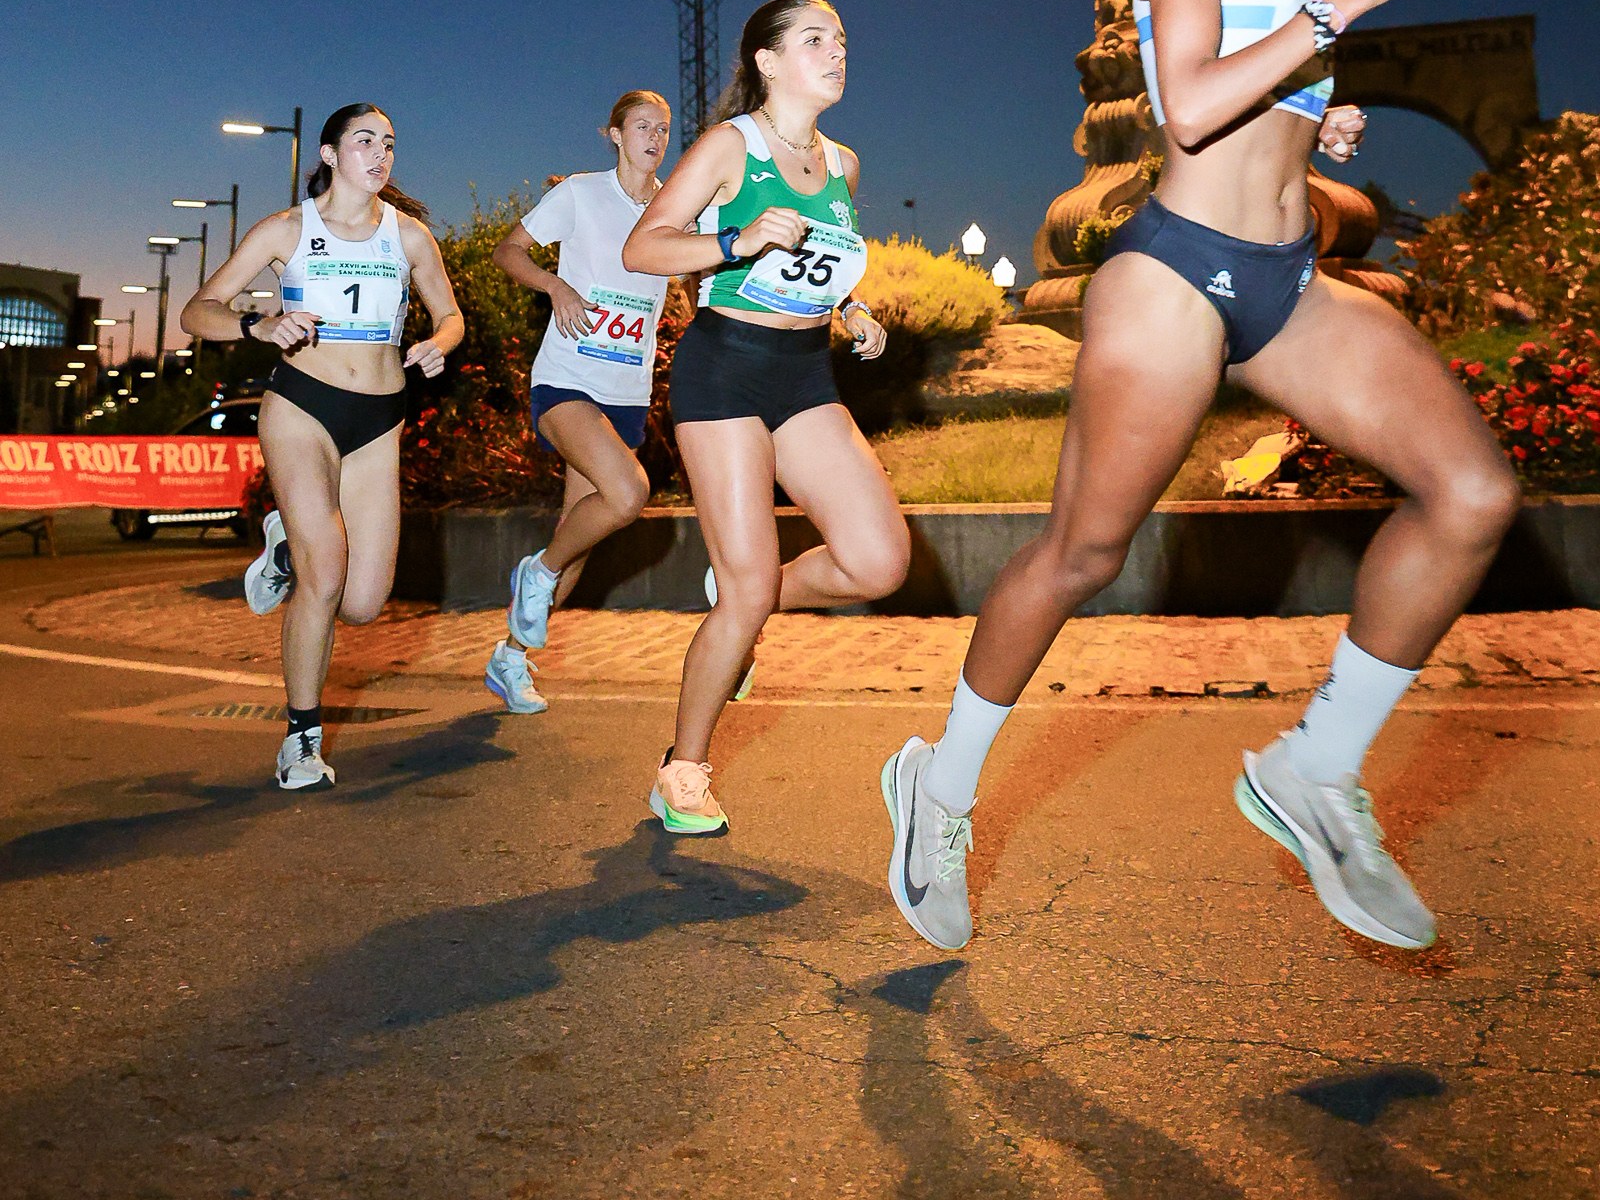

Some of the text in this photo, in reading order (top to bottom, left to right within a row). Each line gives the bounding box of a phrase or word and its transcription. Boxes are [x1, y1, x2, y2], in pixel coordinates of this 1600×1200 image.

[781, 248, 841, 287] 35
[343, 283, 360, 314] 1
[590, 308, 645, 344] 764
[0, 440, 55, 472] OIZ
[57, 441, 141, 473] FROIZ
[147, 442, 231, 474] FROIZ
